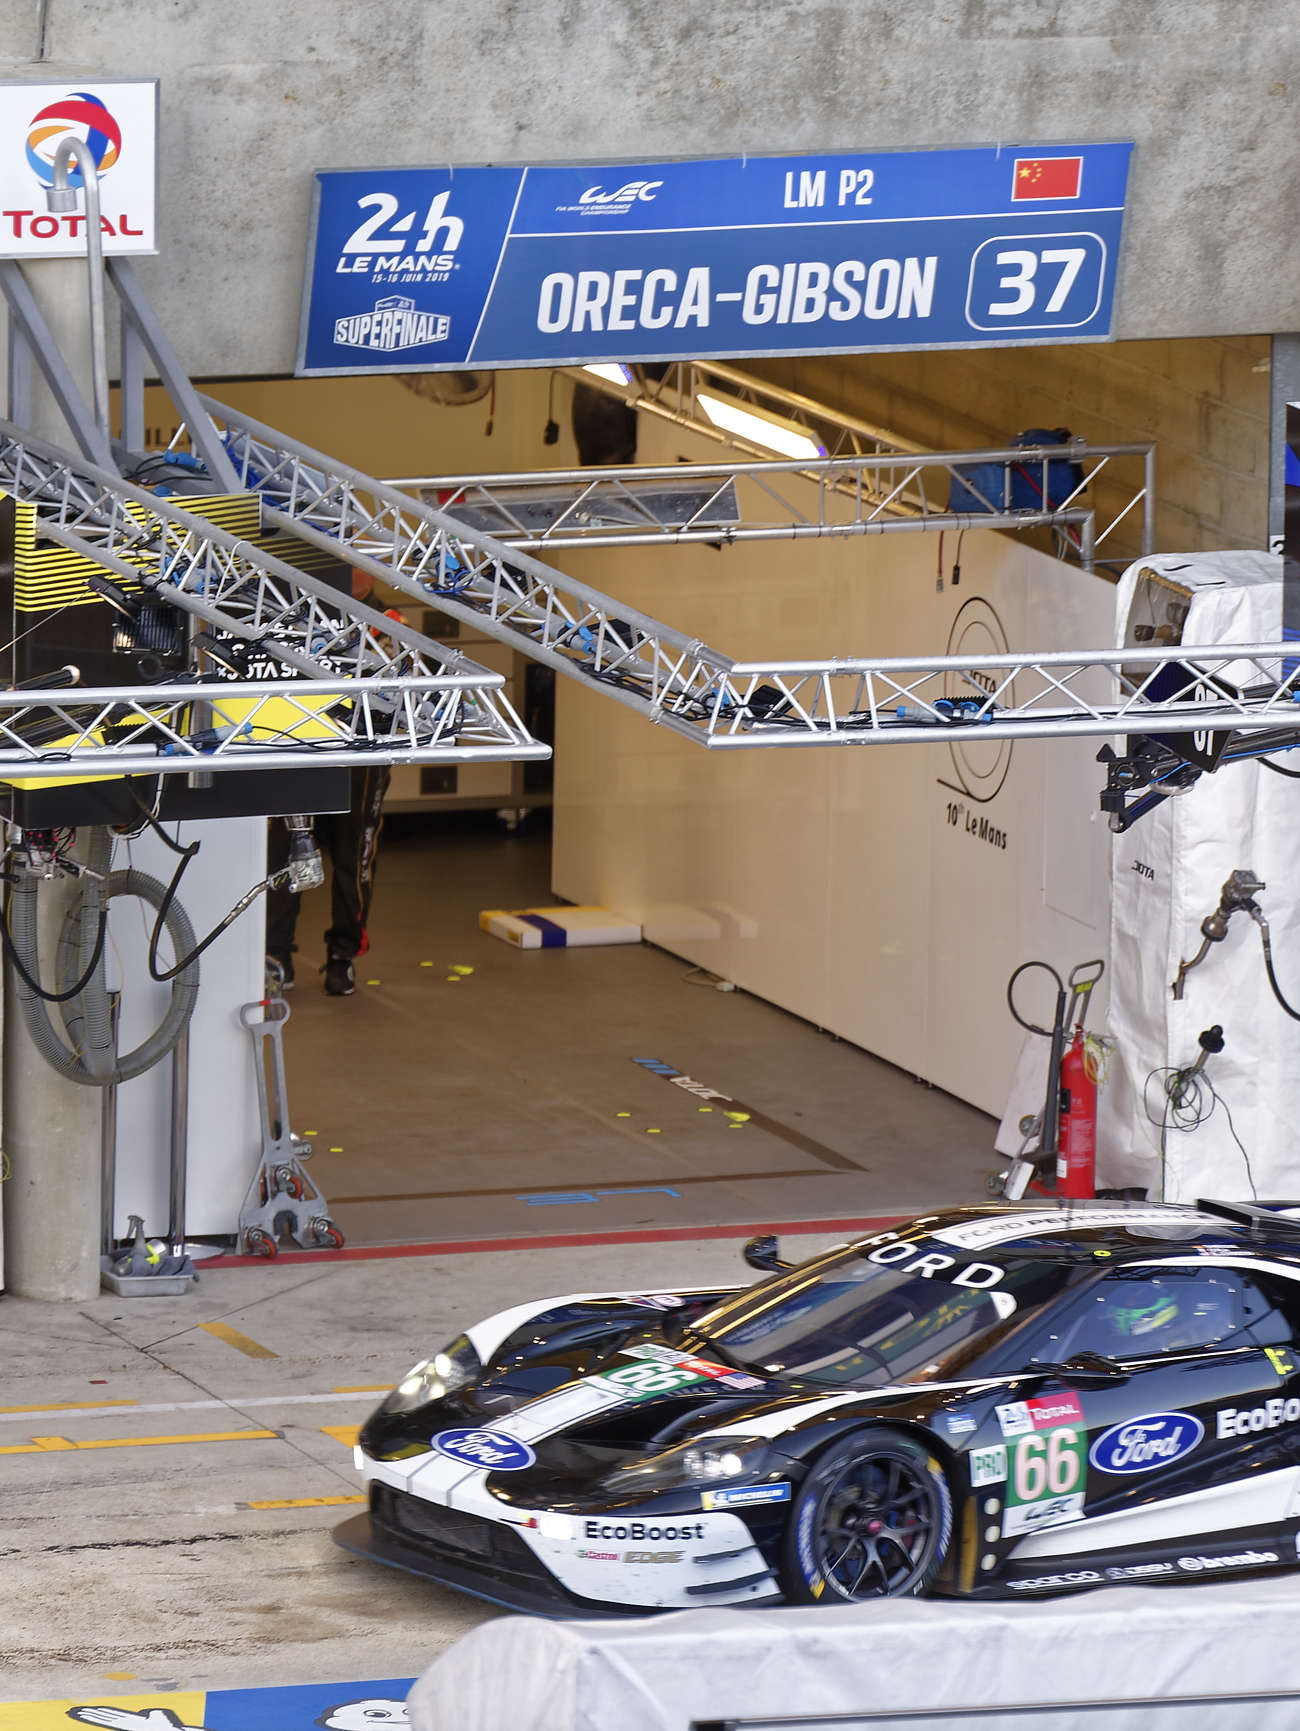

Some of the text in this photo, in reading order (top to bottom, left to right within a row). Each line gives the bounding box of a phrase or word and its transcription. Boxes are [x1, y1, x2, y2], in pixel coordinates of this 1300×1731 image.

[578, 180, 664, 204] WEC
[783, 169, 874, 208] LM P2
[2, 210, 144, 239] TOTAL
[342, 190, 465, 254] 24h
[335, 254, 454, 273] LE MANS
[400, 273, 424, 282] JUIN
[424, 272, 450, 282] 2019
[987, 248, 1086, 317] 37
[537, 256, 938, 335] ORECA-GIBSON
[336, 310, 448, 349] SUPERFINALE
[966, 811, 977, 834] Le
[978, 814, 1008, 850] Mans
[853, 1231, 1005, 1289] FORD
[607, 1362, 700, 1393] 66
[443, 1432, 521, 1464] Ford
[1110, 1420, 1183, 1468] Ford
[1013, 1427, 1081, 1501] 66
[584, 1520, 706, 1541] EcoBoost
